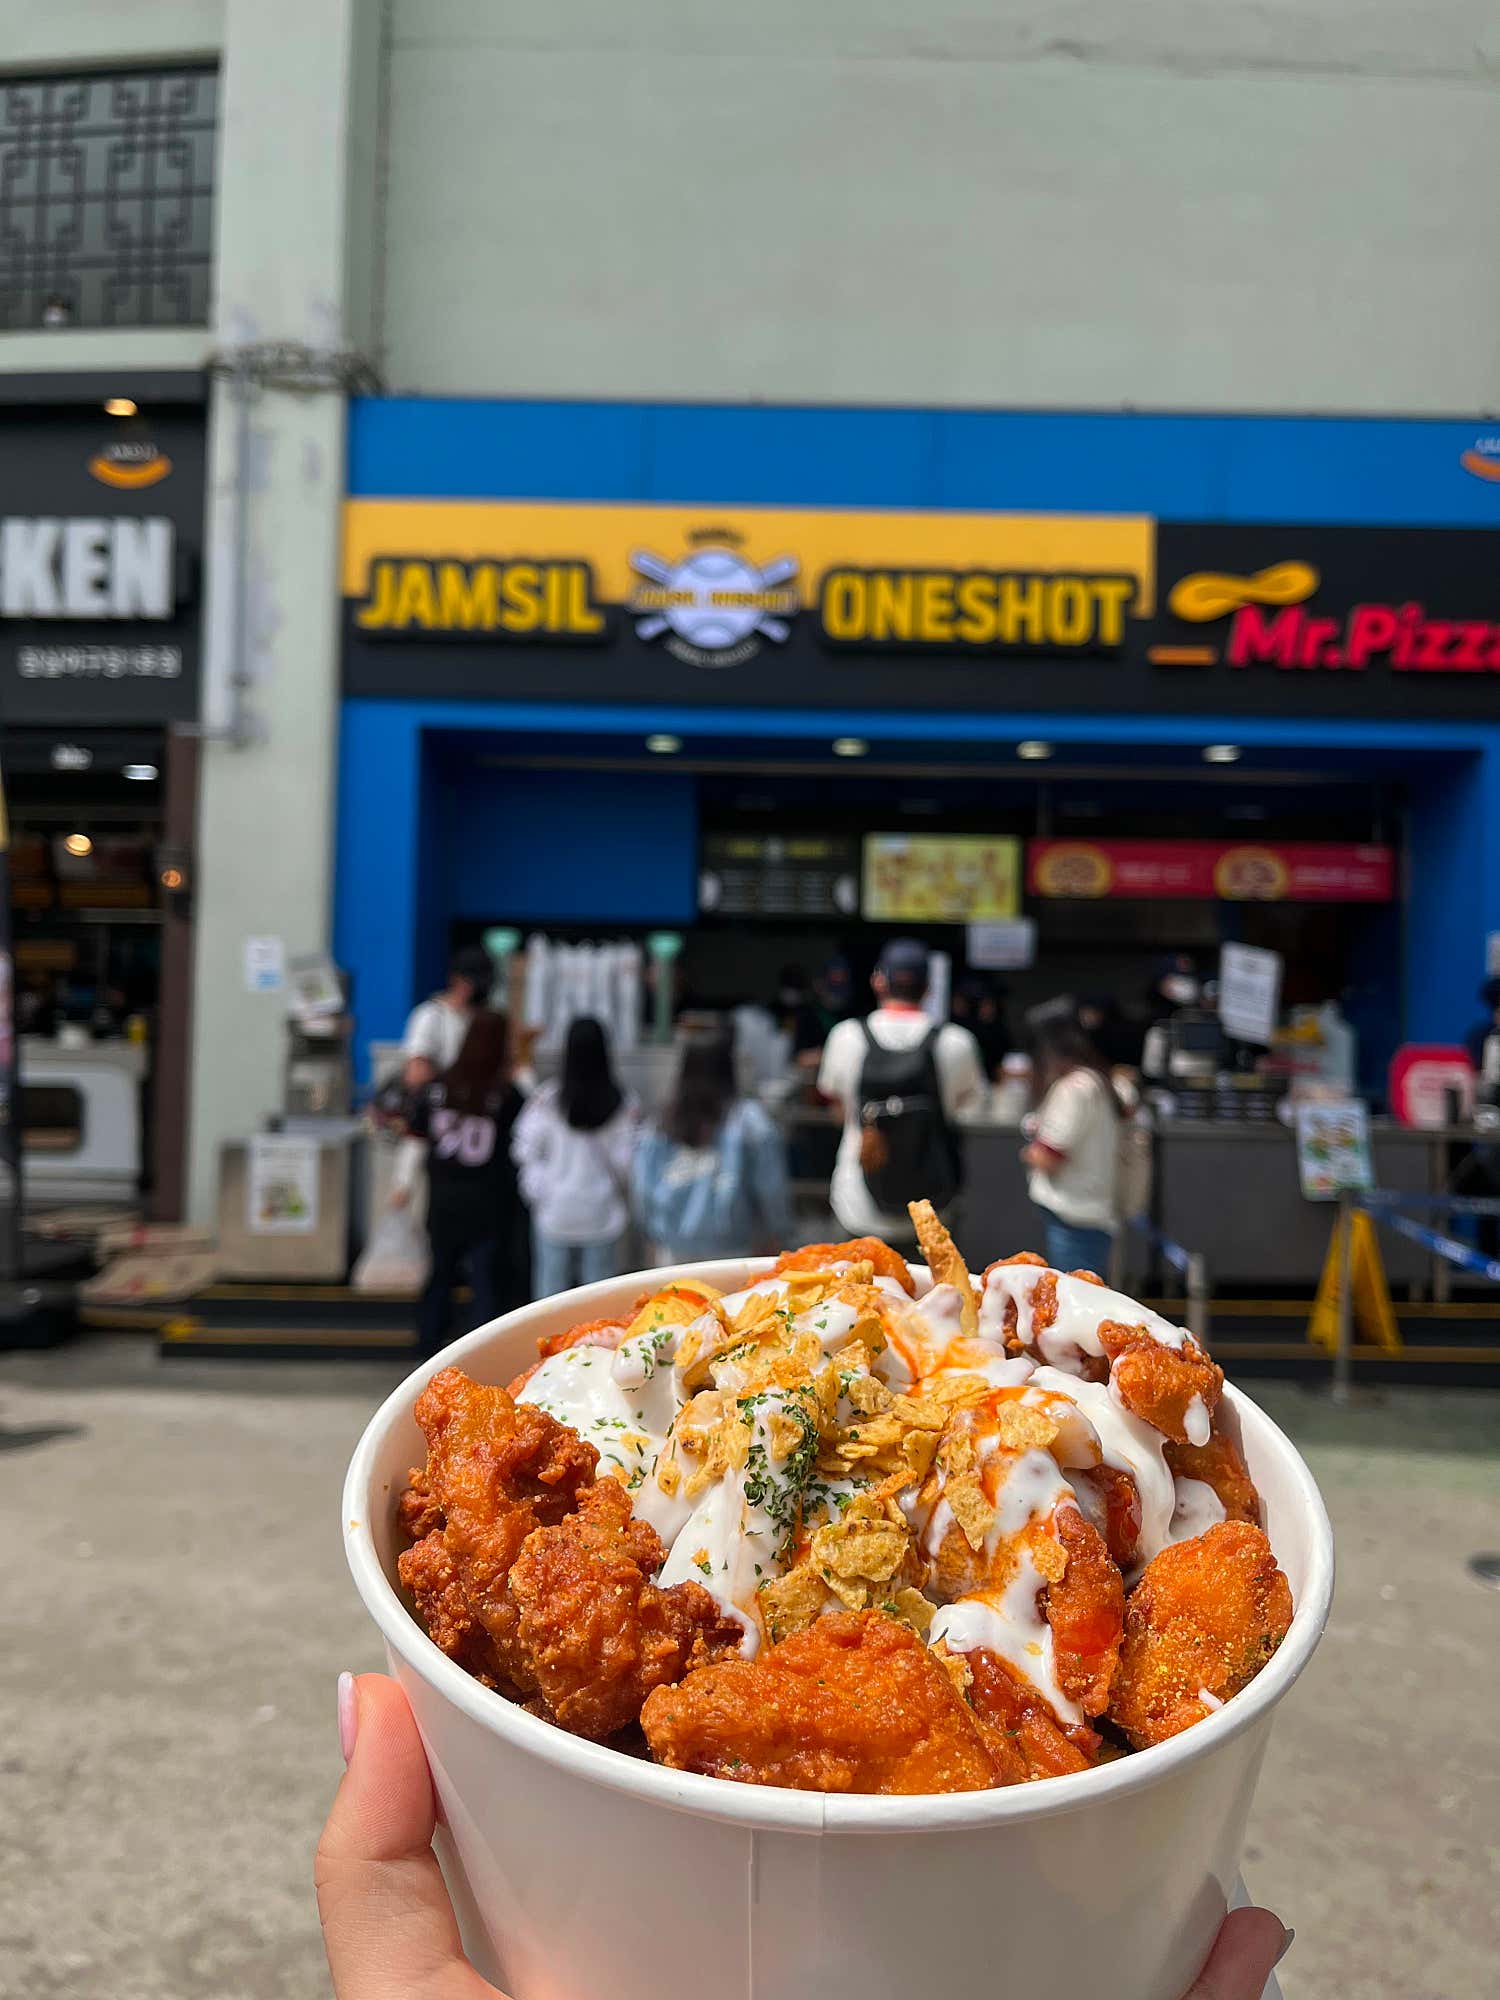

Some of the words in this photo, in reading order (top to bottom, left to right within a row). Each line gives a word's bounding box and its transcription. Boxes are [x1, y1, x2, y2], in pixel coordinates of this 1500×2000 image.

[2, 516, 174, 619] KEN
[357, 561, 605, 633] JAMSIL
[824, 570, 1133, 646] ONESHOT
